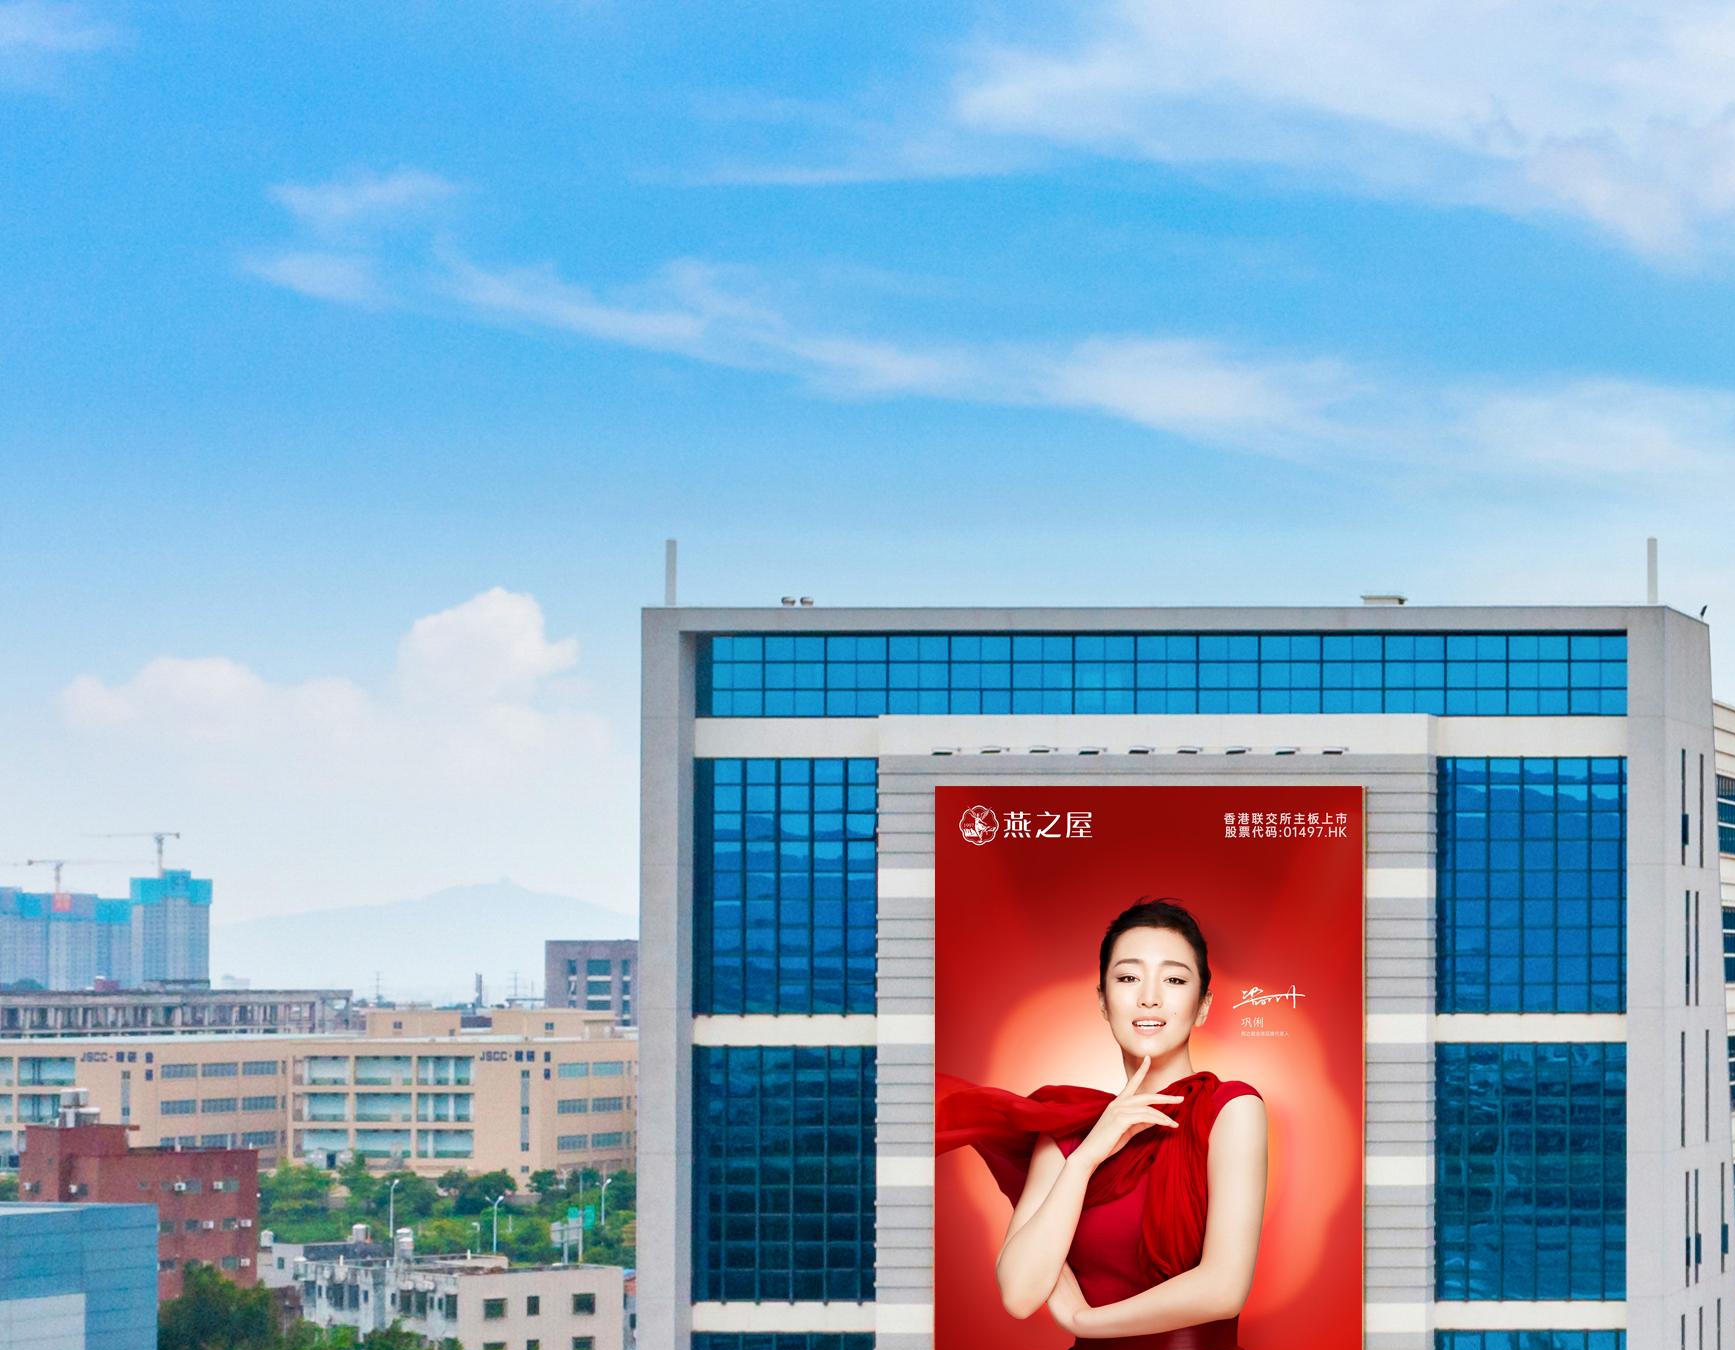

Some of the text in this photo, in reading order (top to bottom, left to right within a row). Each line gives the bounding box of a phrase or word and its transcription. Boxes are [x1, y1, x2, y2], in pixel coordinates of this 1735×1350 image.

[1003, 811, 1093, 838] 燕之屋
[1224, 812, 1347, 825] 香港联交所主板上市
[1225, 826, 1347, 838] 股票代码:01497.HK
